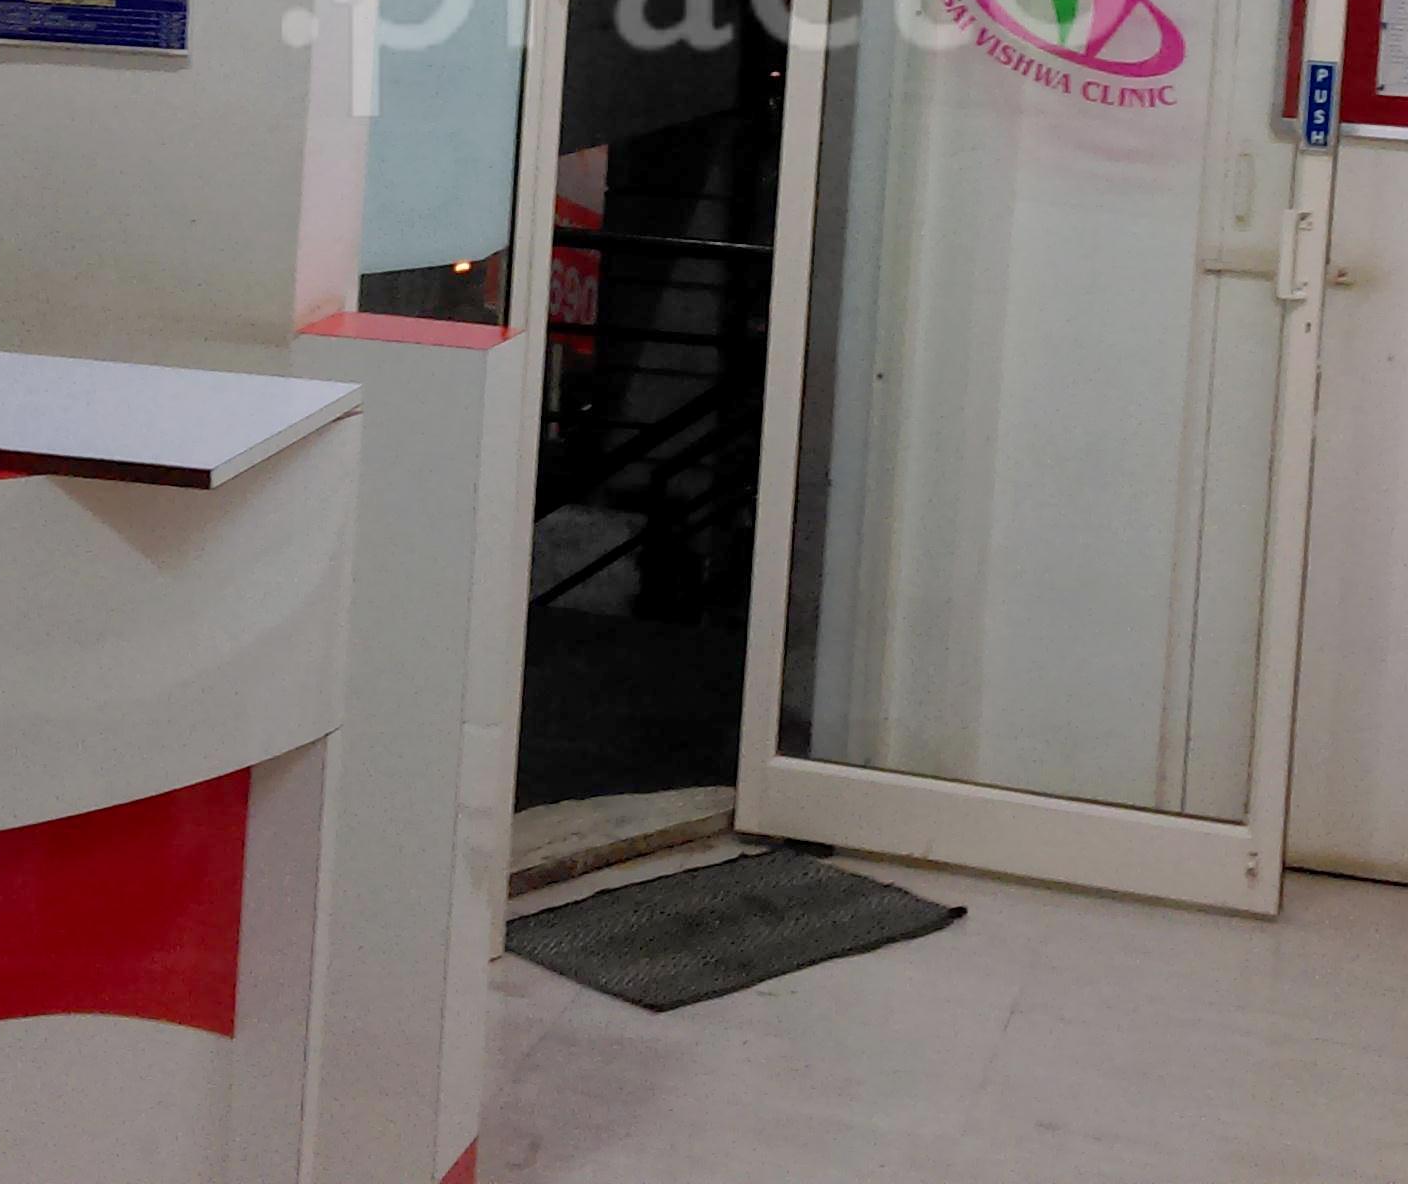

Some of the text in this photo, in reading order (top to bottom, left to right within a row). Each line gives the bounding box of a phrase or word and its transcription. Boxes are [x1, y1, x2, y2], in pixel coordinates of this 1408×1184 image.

[976, 27, 1072, 94] VISHWA
[1081, 79, 1179, 108] CLINIC
[1310, 67, 1330, 145] PUSH
